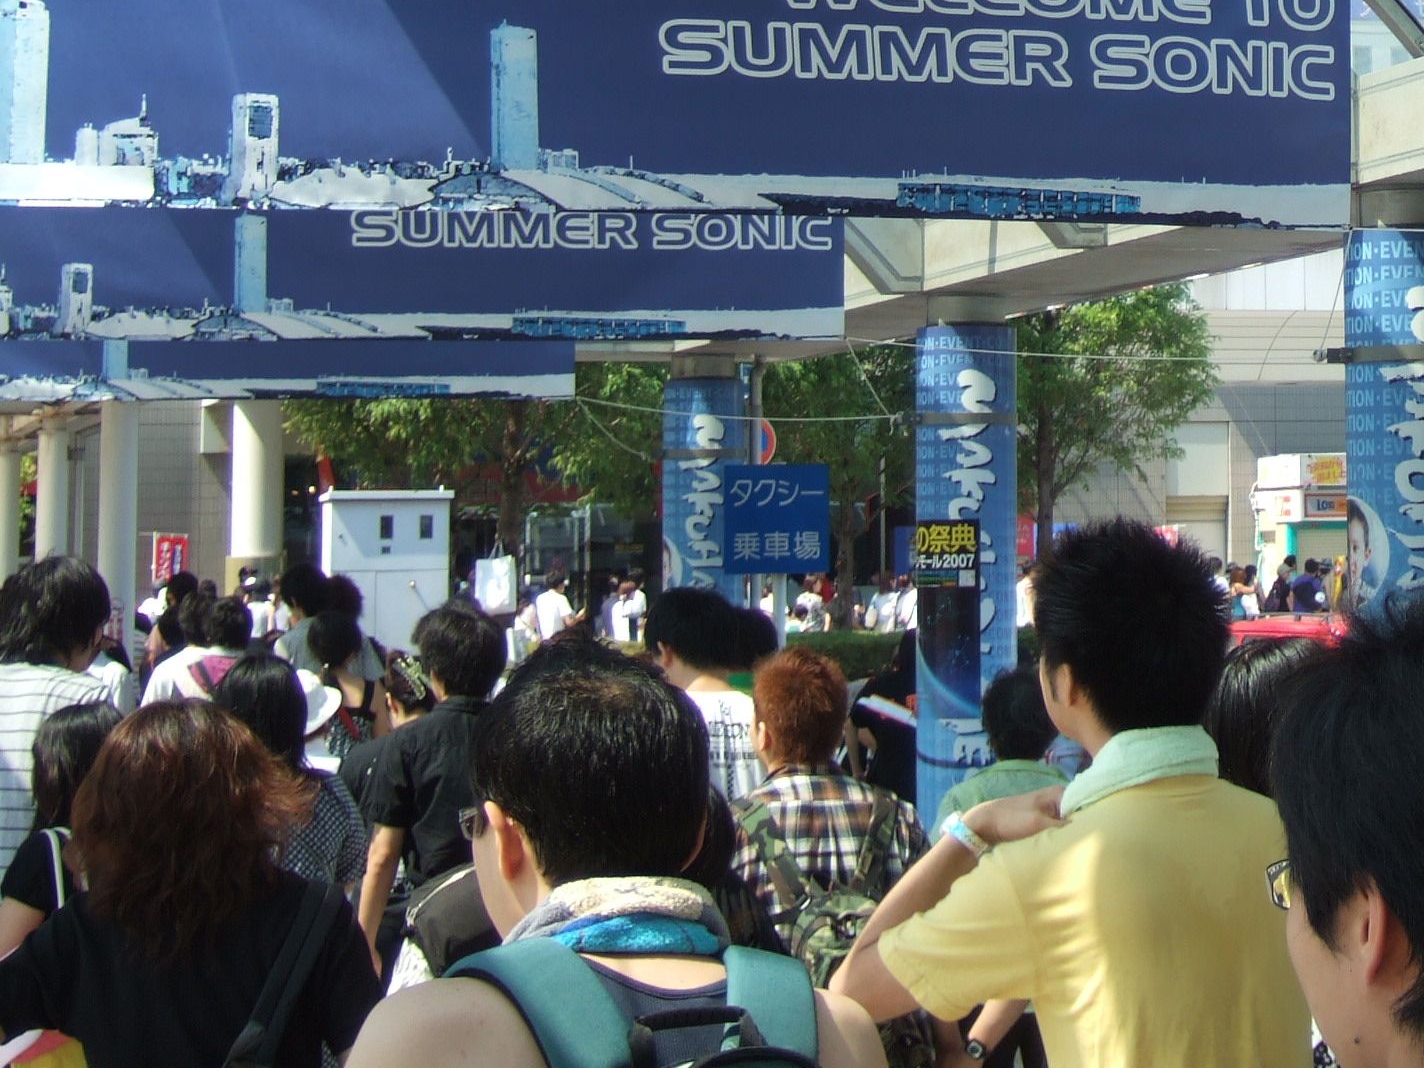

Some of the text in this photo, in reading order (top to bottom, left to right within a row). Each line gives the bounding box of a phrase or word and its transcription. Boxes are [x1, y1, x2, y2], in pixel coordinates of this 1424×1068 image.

[659, 19, 1335, 100] SUMMER SONIC
[350, 209, 833, 251] SUMMER SONIC
[730, 479, 825, 507] タクシー
[733, 531, 821, 560] 乗車場
